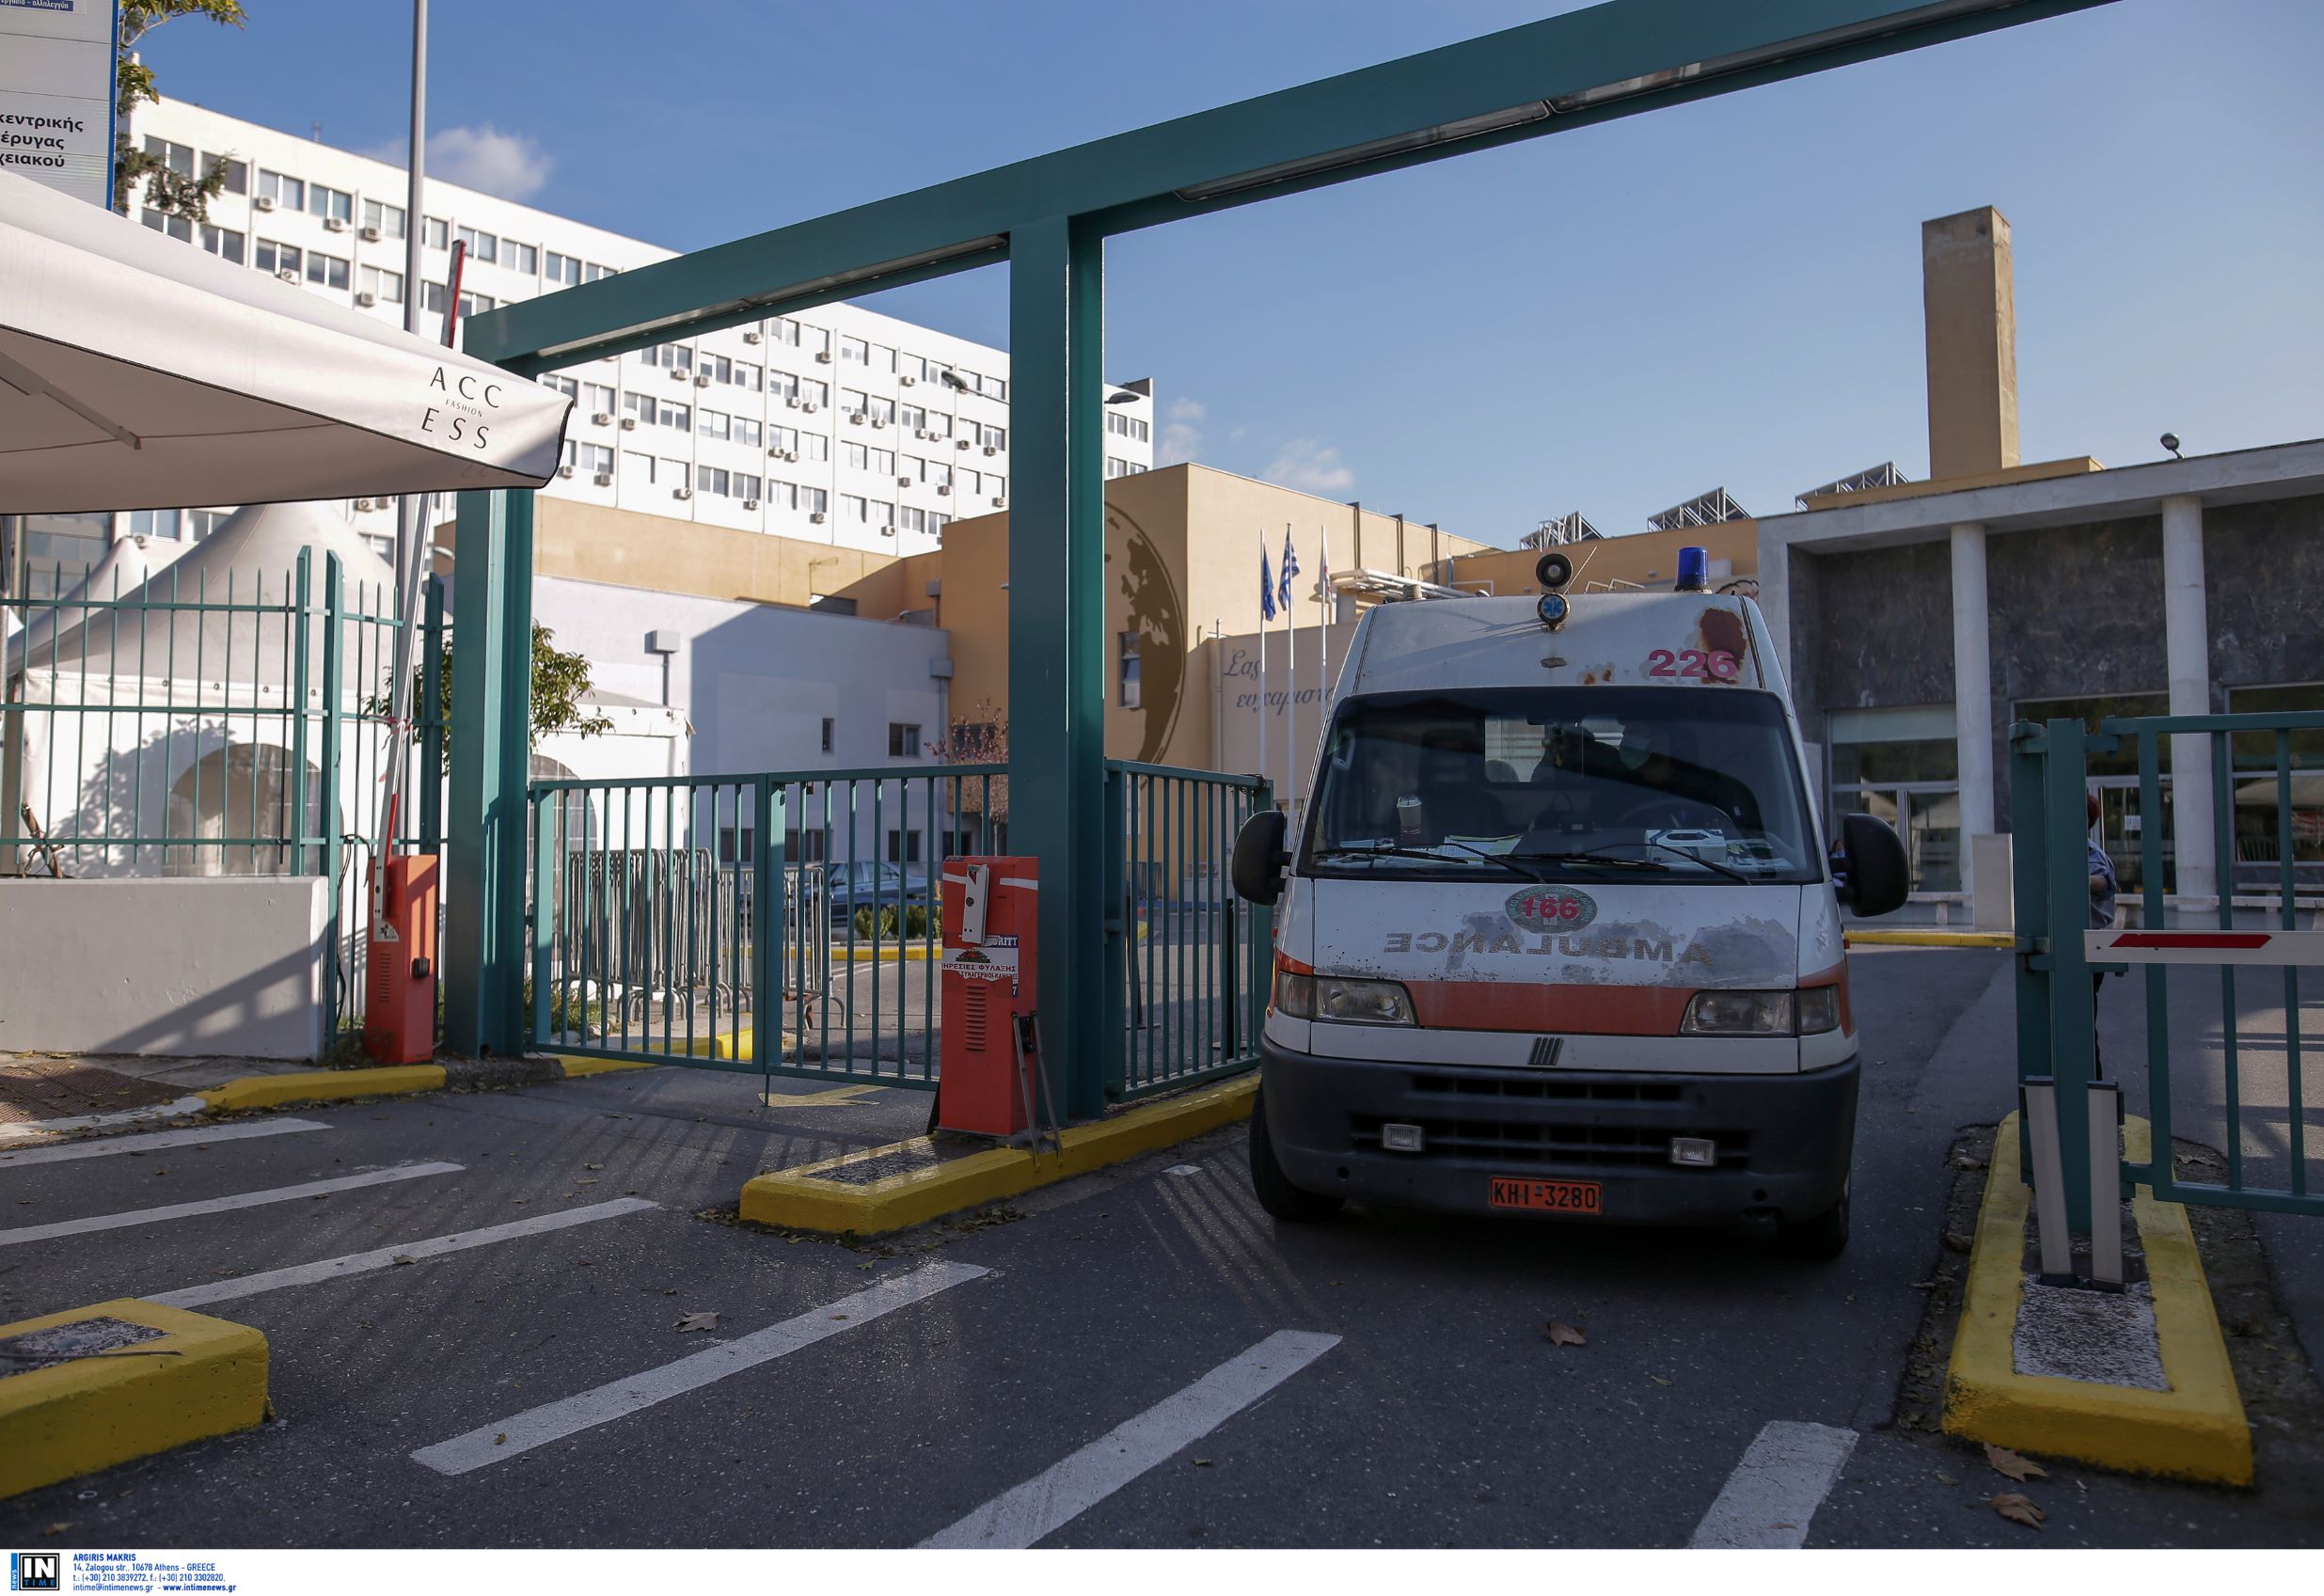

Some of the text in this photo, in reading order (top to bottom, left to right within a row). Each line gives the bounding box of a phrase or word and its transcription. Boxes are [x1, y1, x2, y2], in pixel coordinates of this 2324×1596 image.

[0, 131, 65, 150] έρυγας
[430, 366, 502, 408] ACC
[446, 399, 483, 418] FASHION
[421, 407, 490, 450] ESS
[1648, 649, 1739, 679] 226
[1523, 897, 1580, 920] 166
